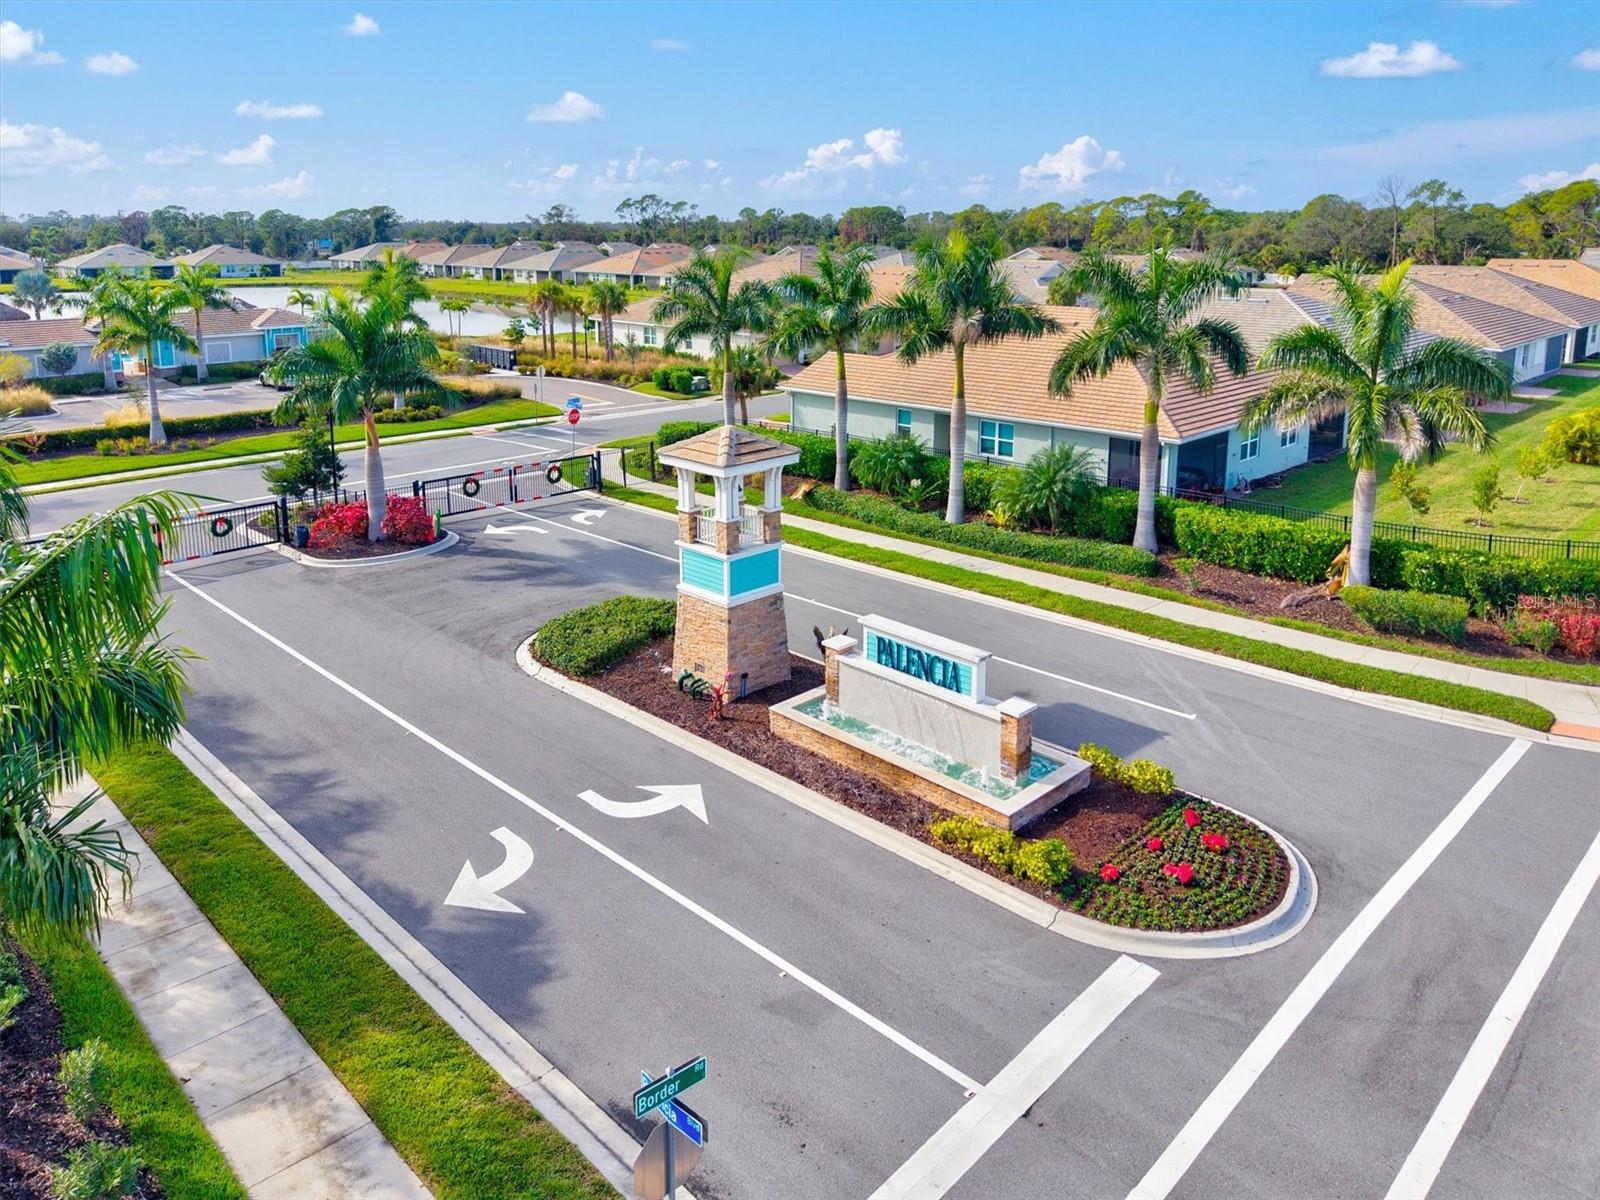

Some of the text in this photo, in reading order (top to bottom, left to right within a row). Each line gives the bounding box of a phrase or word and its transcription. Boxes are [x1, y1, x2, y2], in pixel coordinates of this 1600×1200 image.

[876, 635, 961, 693] PALENCIA
[638, 1080, 679, 1112] Border
[694, 1062, 704, 1072] Rd
